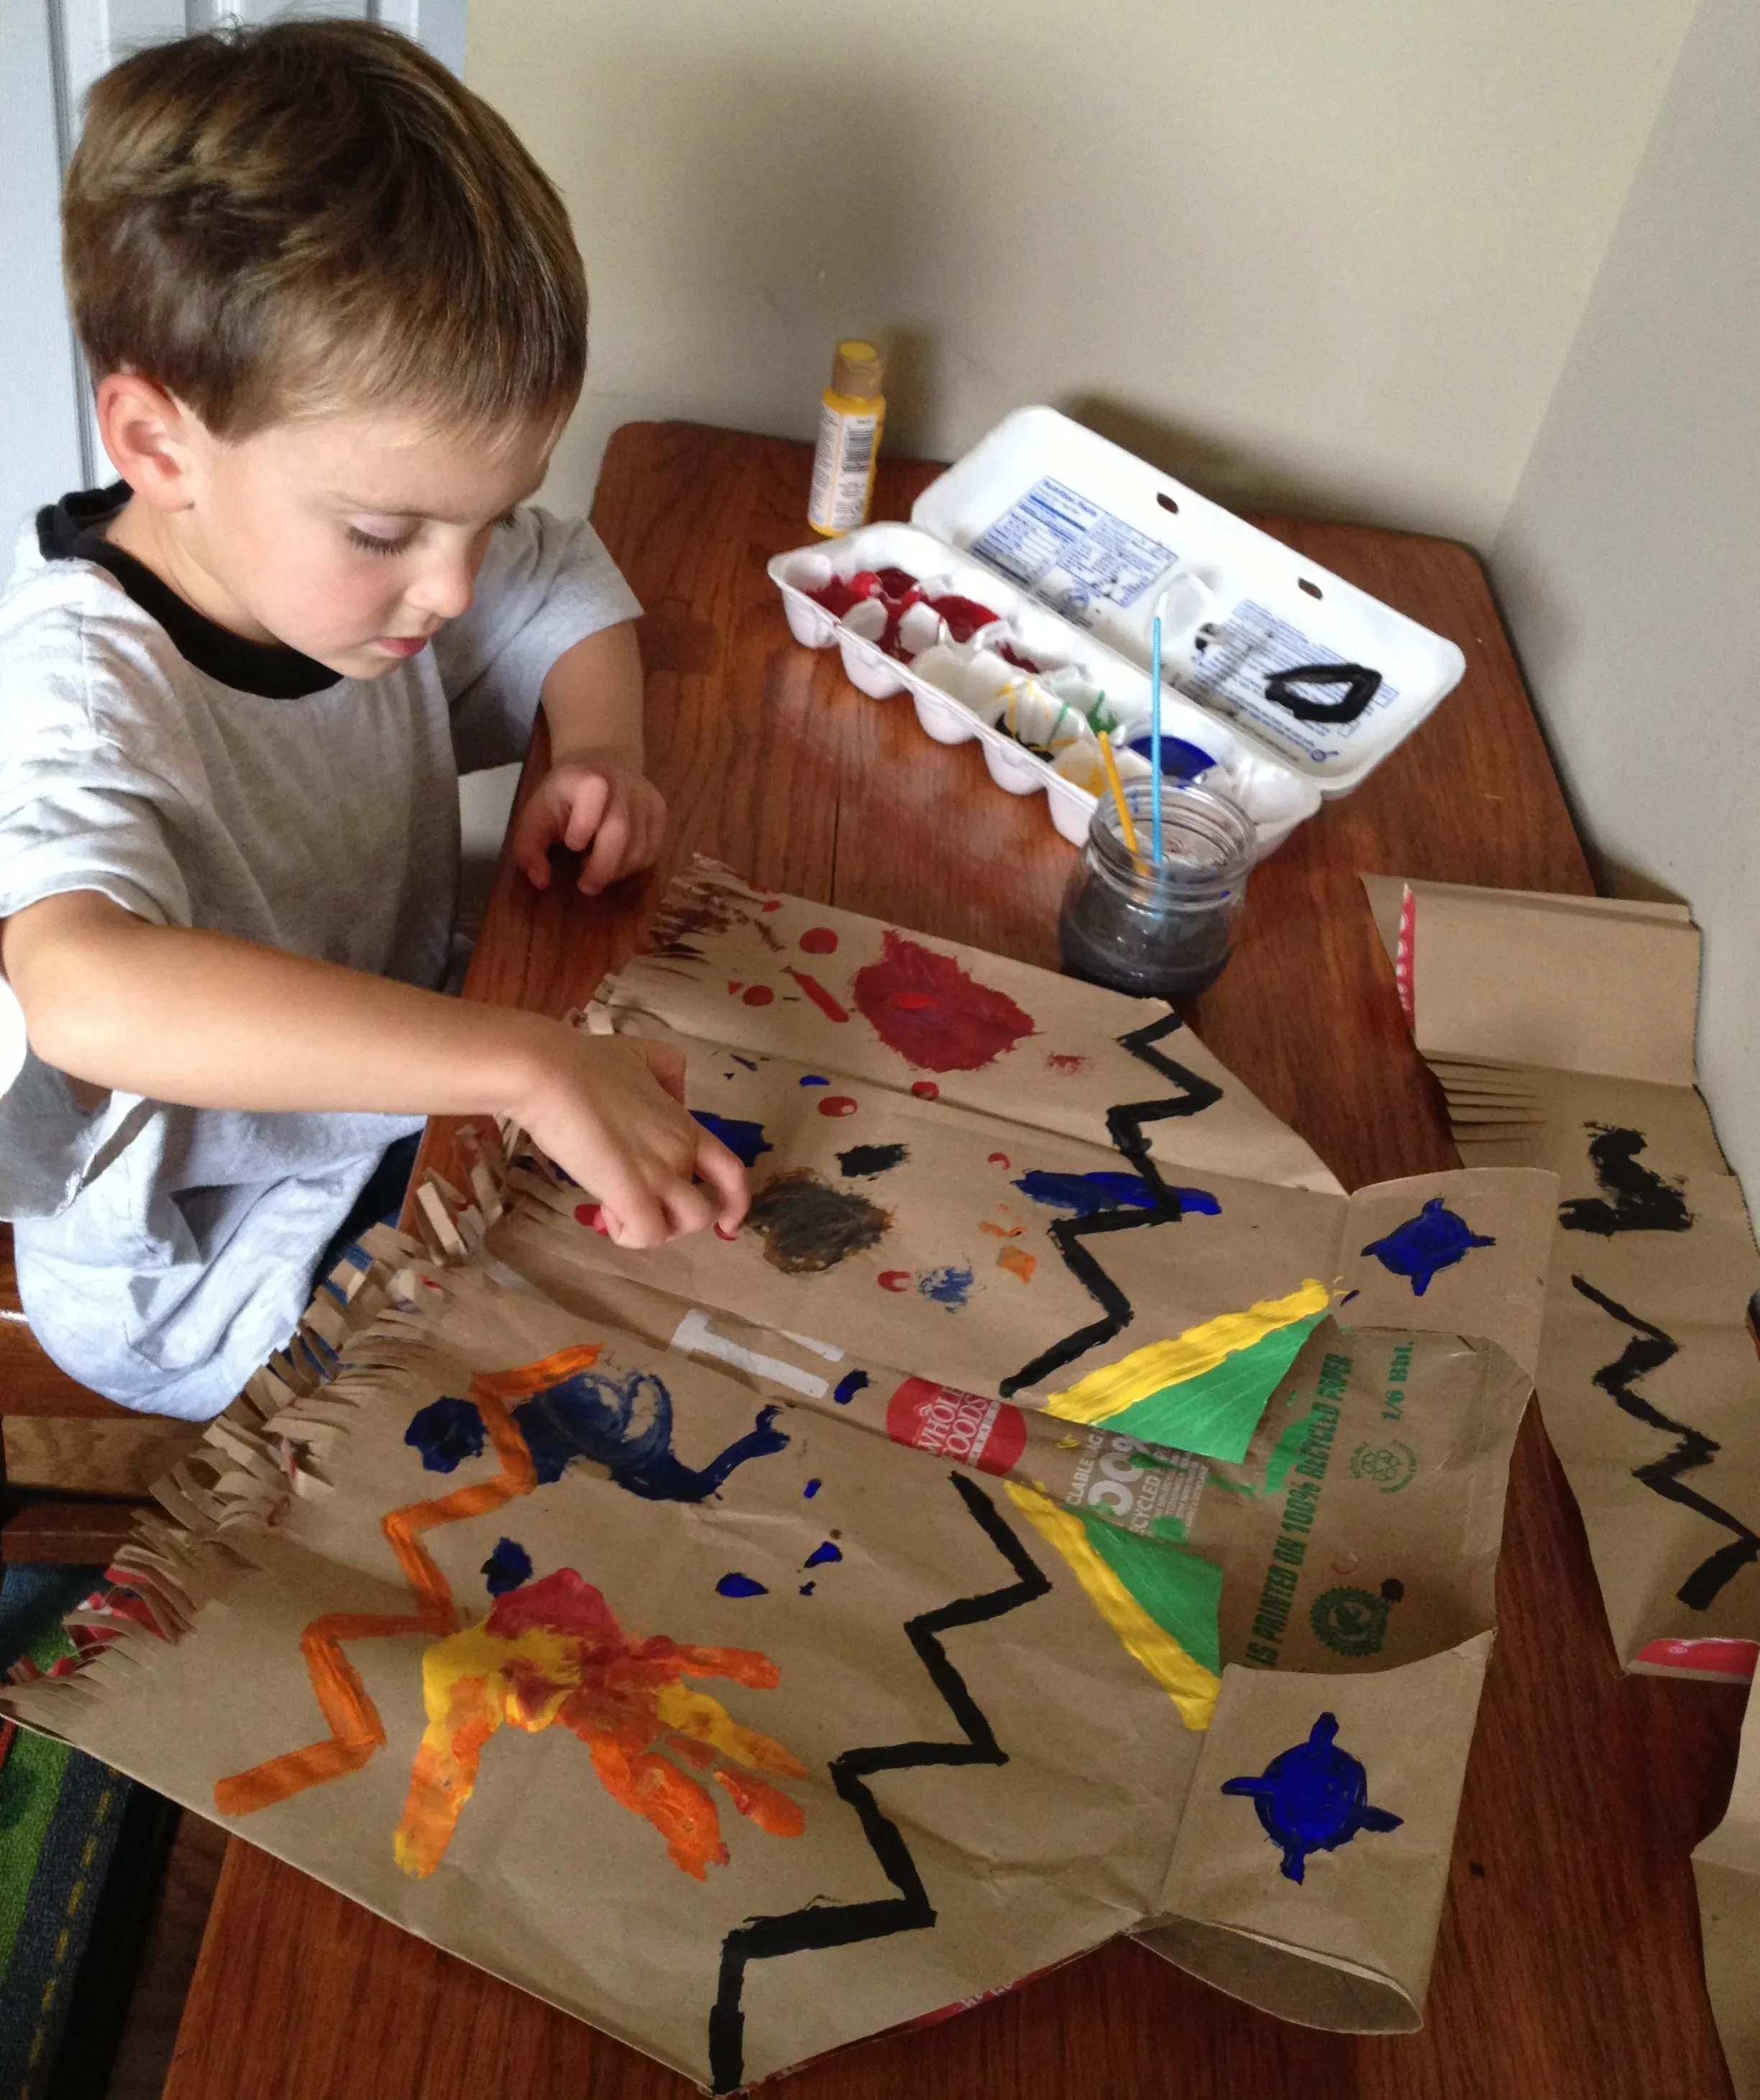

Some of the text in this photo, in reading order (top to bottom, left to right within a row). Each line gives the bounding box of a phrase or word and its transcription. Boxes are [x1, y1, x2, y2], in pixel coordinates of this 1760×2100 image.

[1381, 1342, 1414, 1421] 1/6 Bbl.
[943, 1393, 988, 1454] OODS
[1087, 1436, 1151, 1518] 00%
[1245, 1353, 1354, 1667] IS PRINTED ON 100% RECYCLED PAPER
